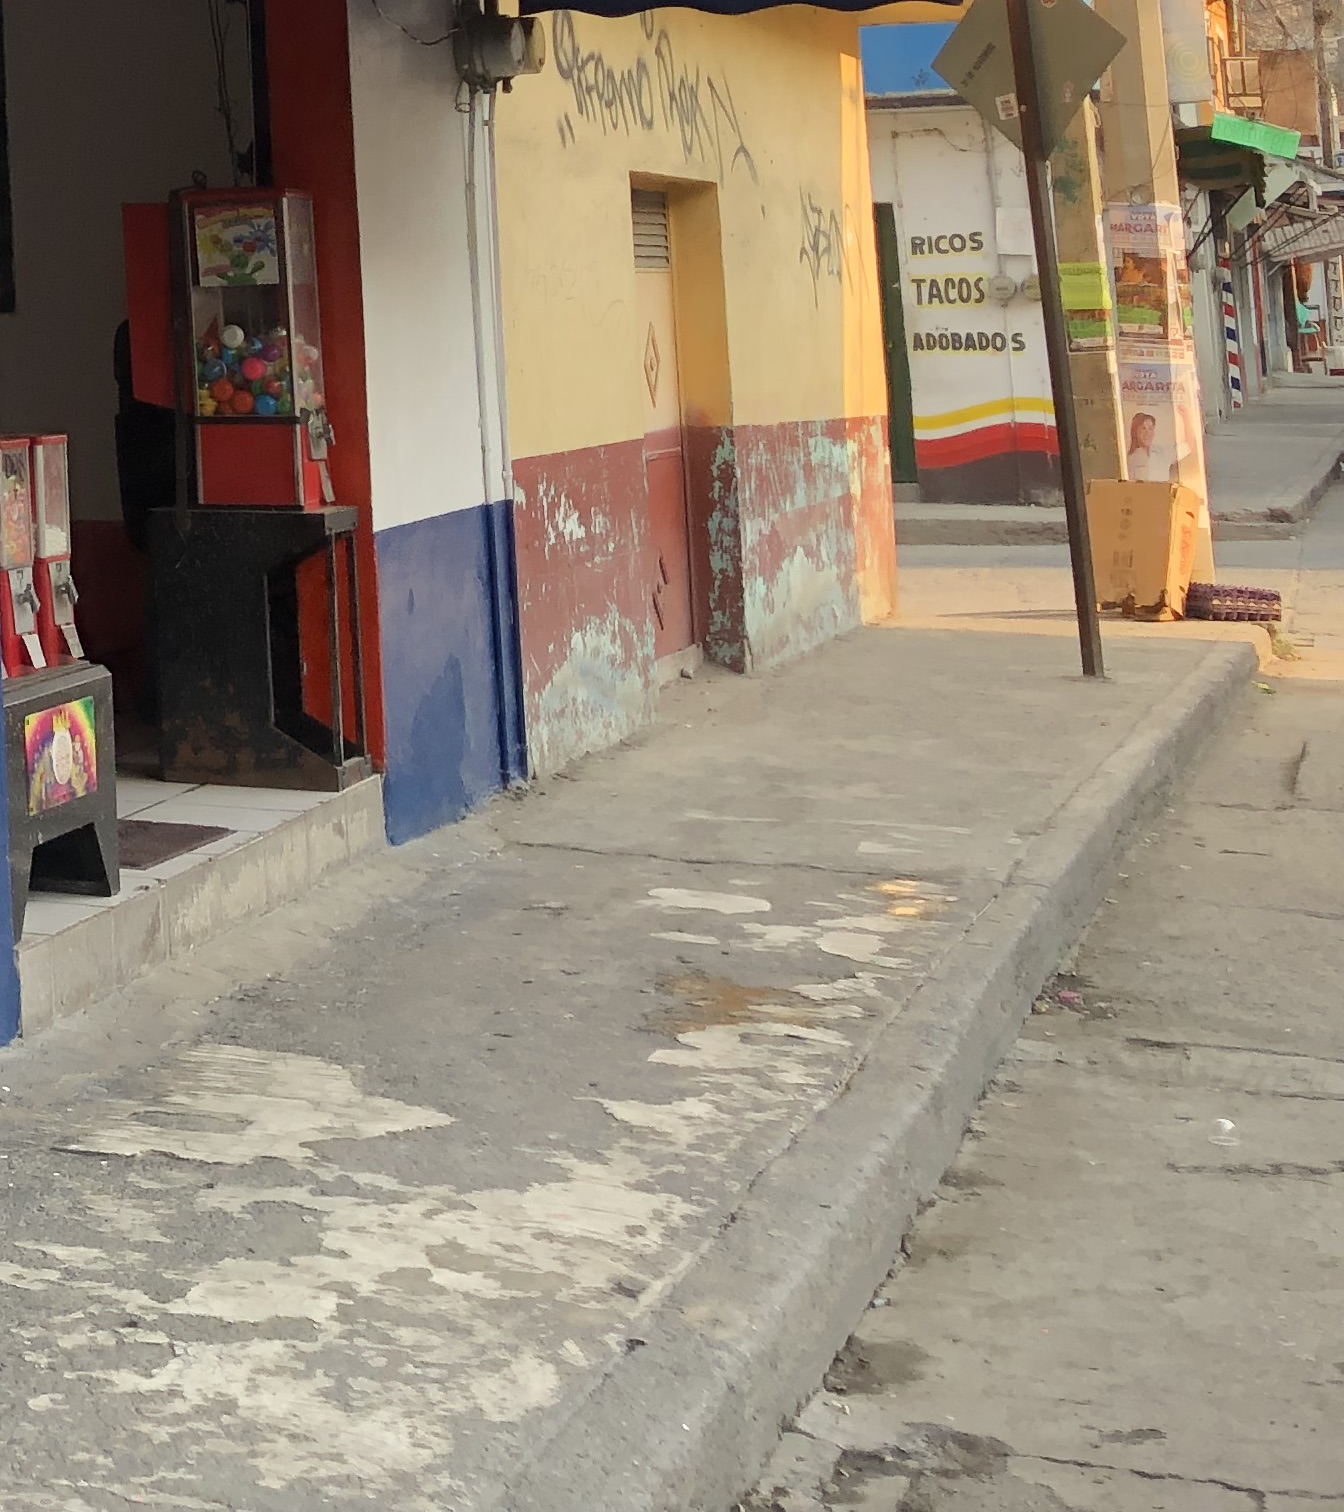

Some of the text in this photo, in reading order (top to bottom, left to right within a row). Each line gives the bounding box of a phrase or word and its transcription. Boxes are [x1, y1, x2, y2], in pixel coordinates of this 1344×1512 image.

[911, 232, 984, 256] RICOS
[911, 276, 986, 306] TACOS
[912, 331, 1027, 352] ADOBADOS
